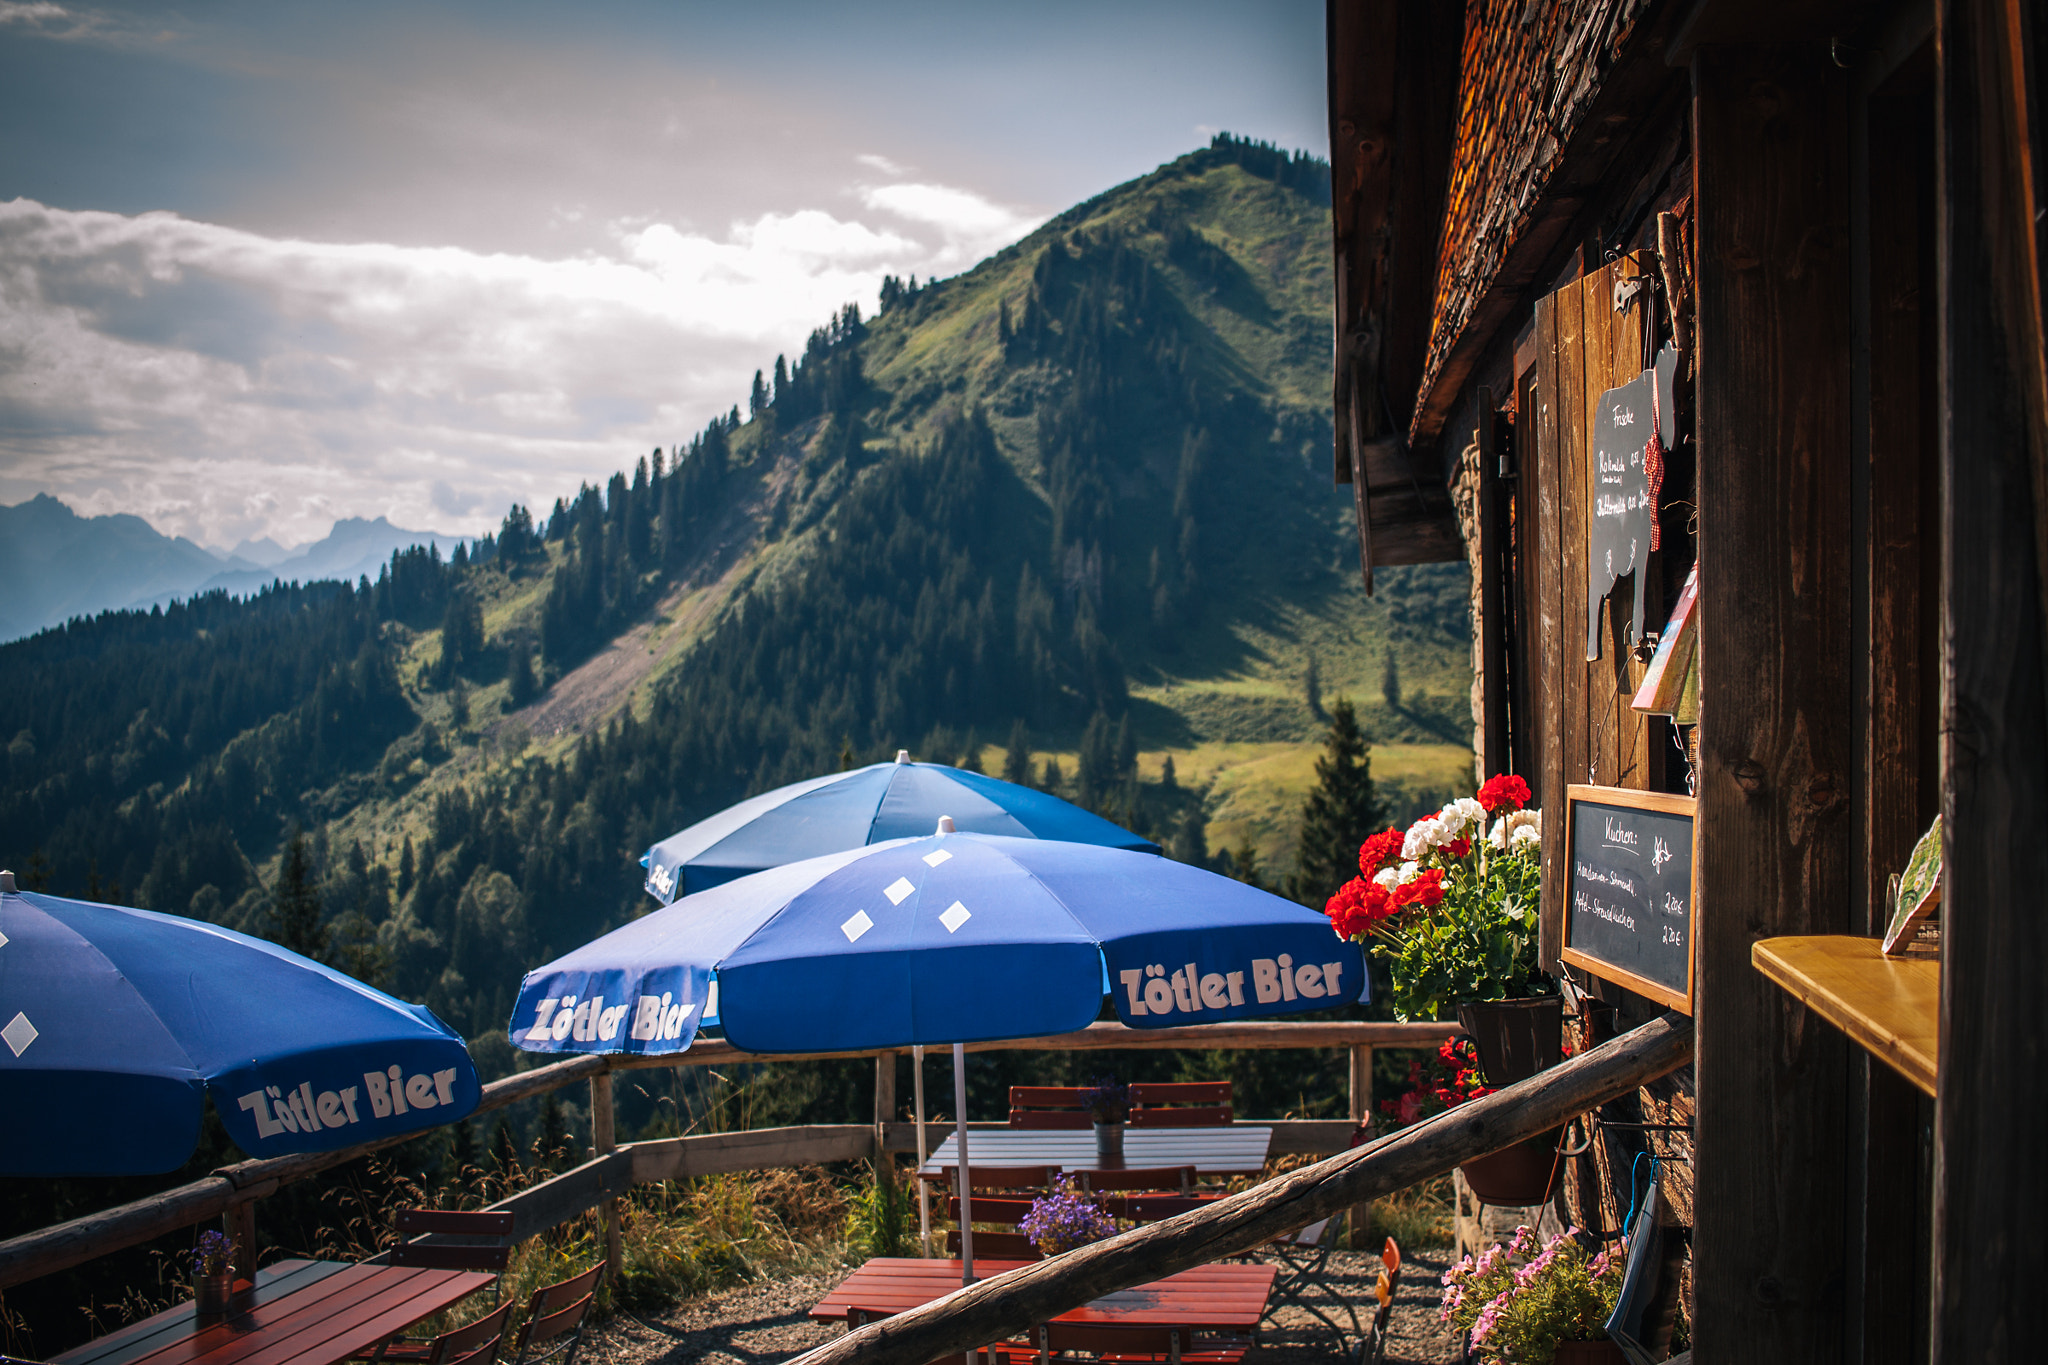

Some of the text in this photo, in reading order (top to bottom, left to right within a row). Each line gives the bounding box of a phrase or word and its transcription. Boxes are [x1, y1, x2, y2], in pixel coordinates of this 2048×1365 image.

[1605, 816, 1638, 845] Kuchen:
[1120, 953, 1343, 1016] Zötler Bier
[524, 991, 697, 1042] Zötler Bier
[237, 1064, 457, 1140] Zötler Bier
